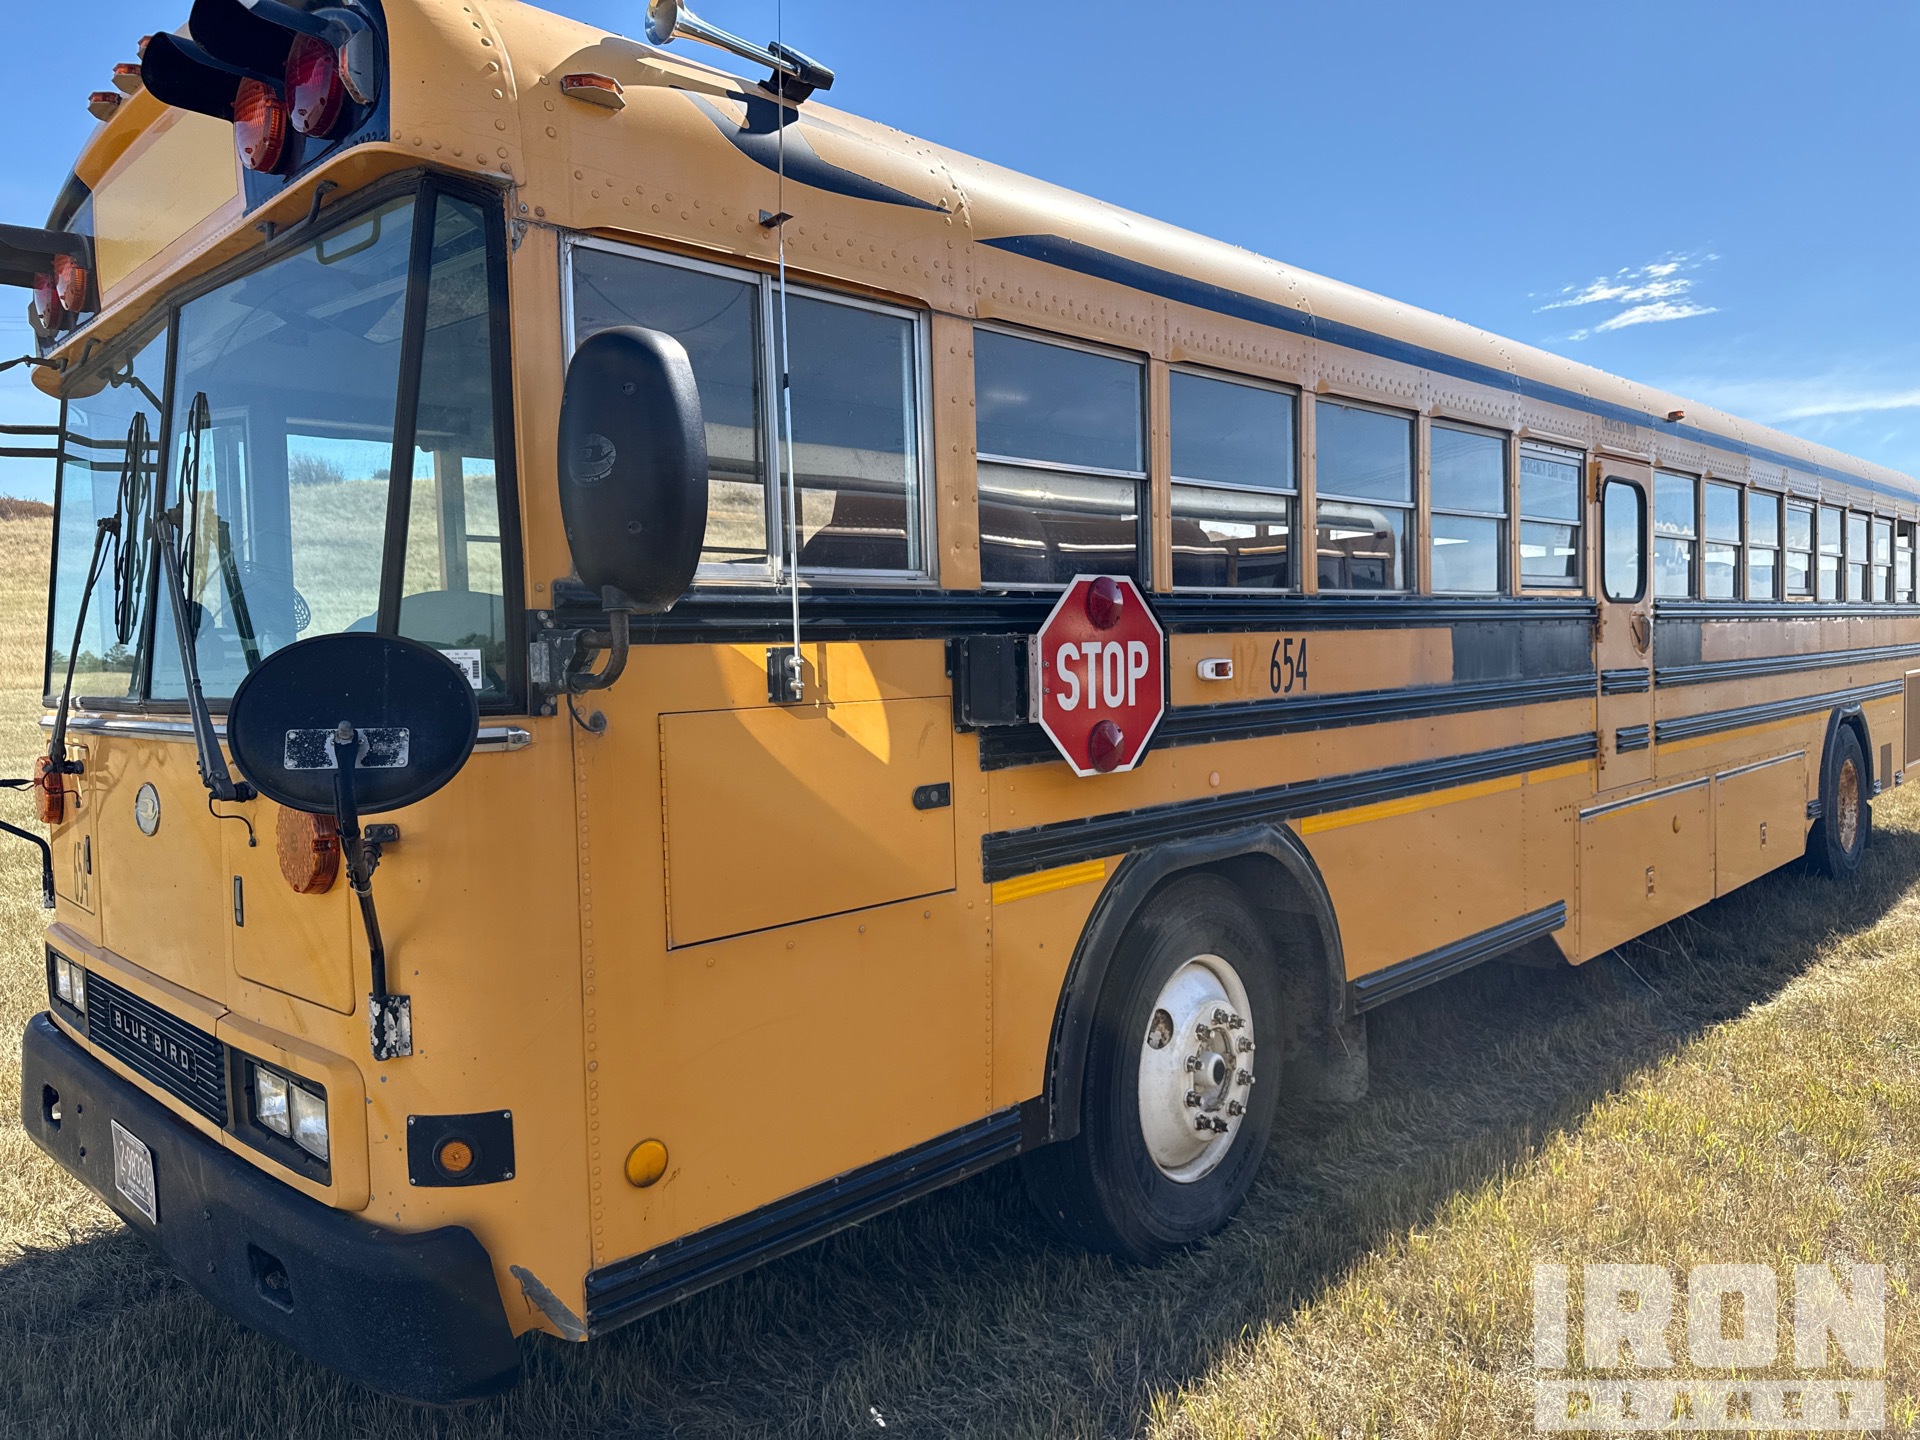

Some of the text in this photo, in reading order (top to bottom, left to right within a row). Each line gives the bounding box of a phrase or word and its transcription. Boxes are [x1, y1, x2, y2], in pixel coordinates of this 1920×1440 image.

[1520, 458, 1546, 477] MERGENCY
[1056, 641, 1149, 711] STOP
[1270, 638, 1307, 693] 654
[74, 841, 89, 907] 654
[115, 1010, 188, 1070] BLUE BIRD
